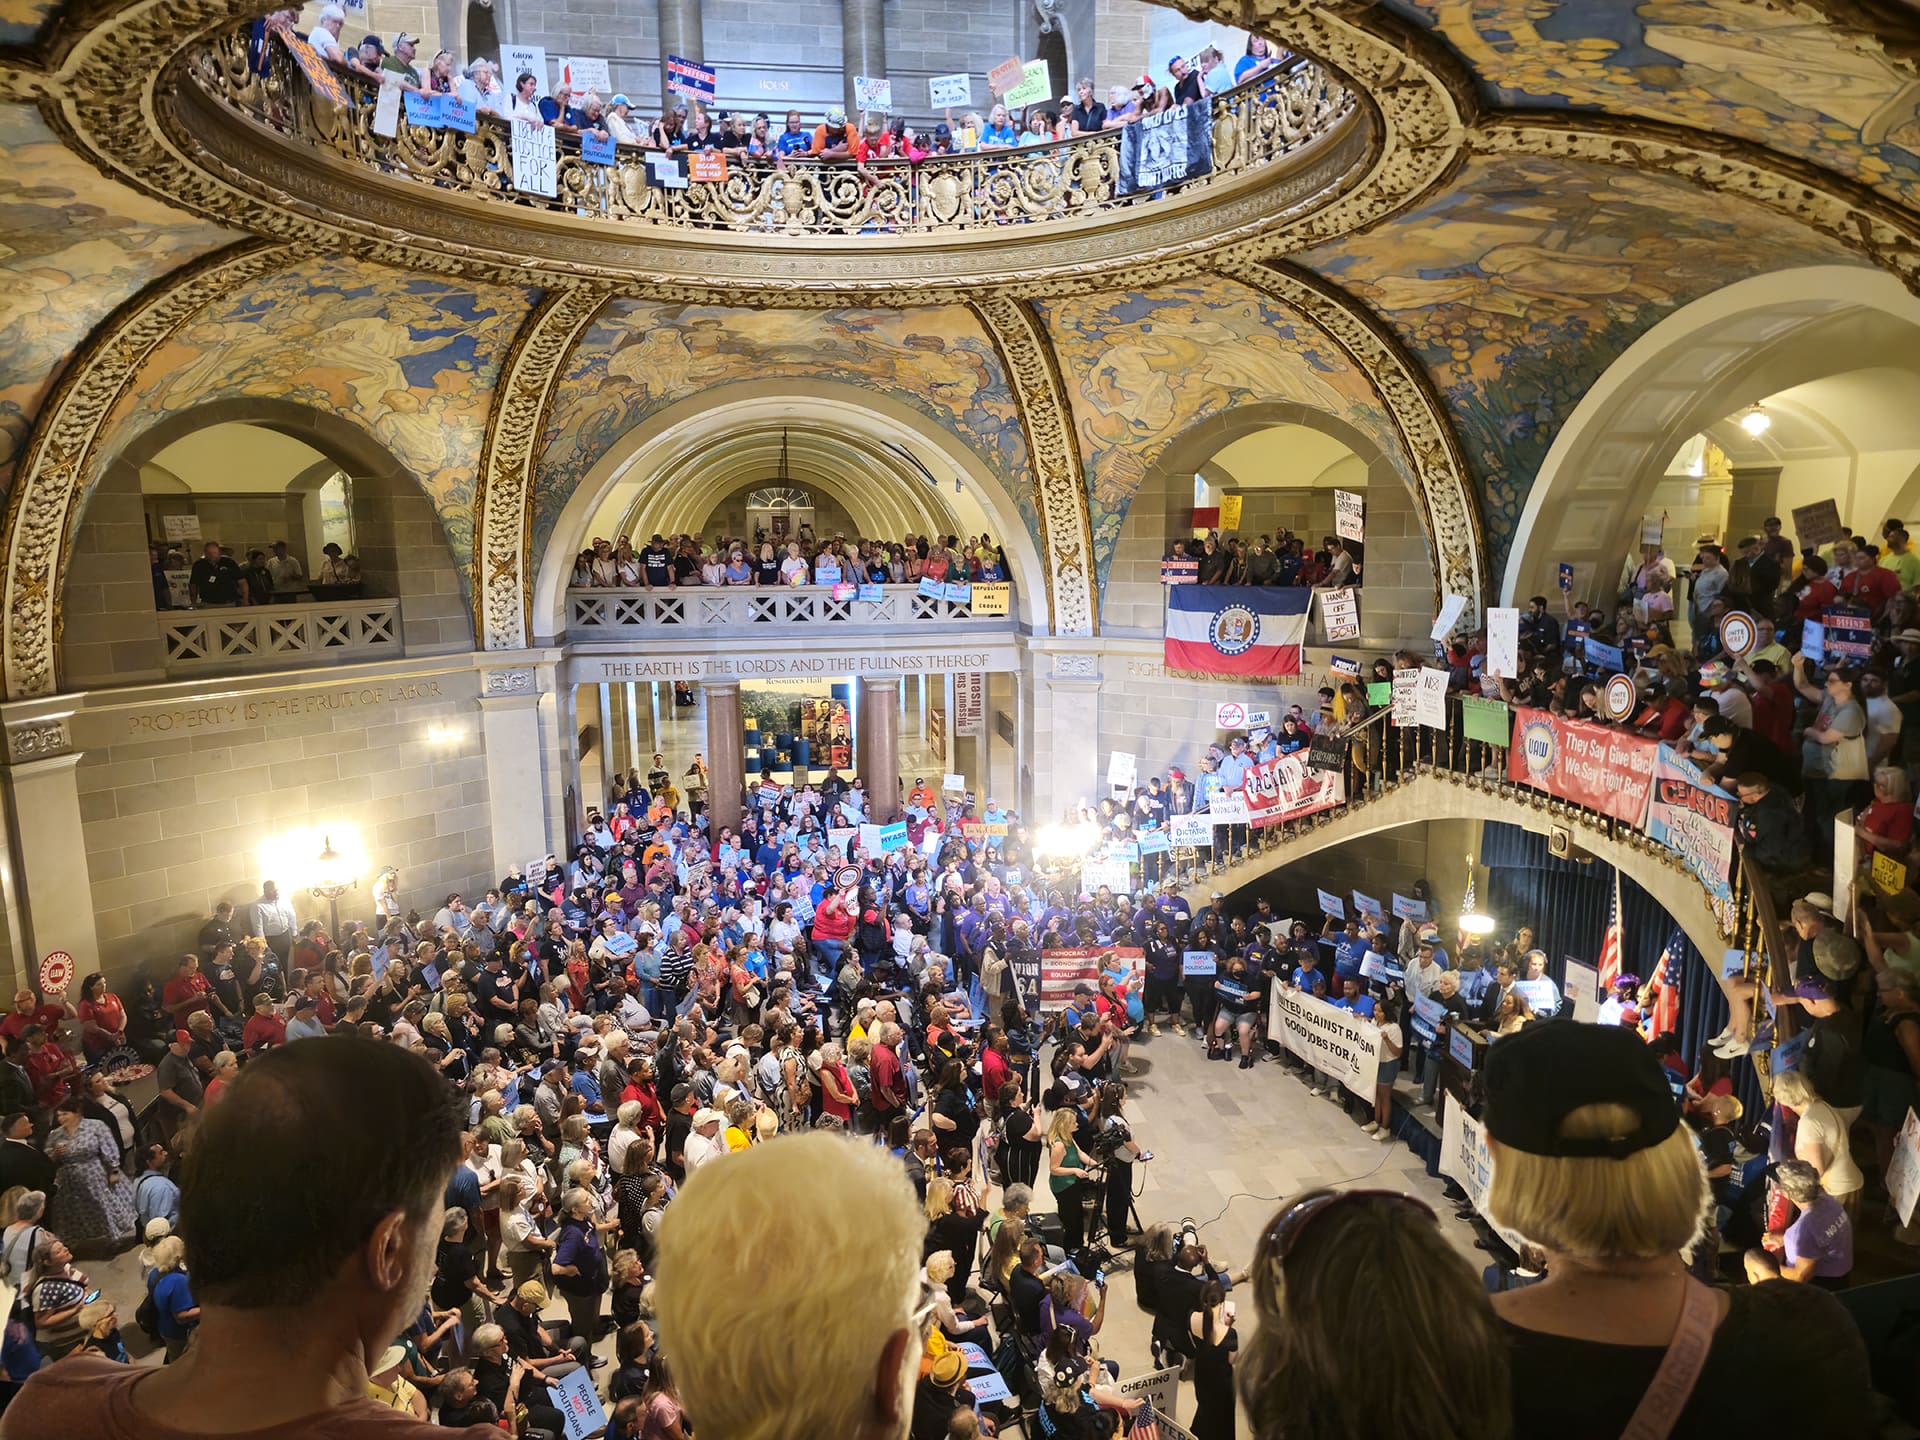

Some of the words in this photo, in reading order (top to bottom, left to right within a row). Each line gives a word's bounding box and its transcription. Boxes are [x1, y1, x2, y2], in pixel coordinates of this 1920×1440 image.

[682, 67, 711, 82] DEFEND
[759, 80, 789, 91] HOUSE
[448, 100, 469, 112] PEOPLE
[451, 109, 464, 117] NOT
[442, 112, 474, 127] POLITICIANS
[513, 138, 555, 161] JUSTICE
[519, 156, 548, 177] FOR
[519, 175, 549, 193] ALL
[1326, 590, 1350, 603] HANDS
[1333, 604, 1345, 613] OFF
[1335, 616, 1346, 625] MY
[1836, 617, 1865, 628] DEFEND
[1727, 628, 1745, 637] UNITE
[1824, 640, 1871, 656] CONSTITUTION
[601, 662, 631, 676] THE
[636, 661, 683, 676] EARTH
[688, 661, 700, 675] IS
[702, 660, 732, 674] THE
[736, 659, 786, 673] LORD'S
[790, 658, 824, 672] AND
[828, 657, 855, 671] THE
[860, 656, 923, 670] FULLNESS
[927, 654, 990, 668] THEREOF
[1335, 659, 1357, 672] PEOPLE
[765, 676, 805, 685] Resources
[807, 675, 822, 684] Hall
[1611, 691, 1626, 699] UNITE
[129, 703, 238, 735] PROPERTY
[244, 702, 258, 720] IS
[262, 696, 299, 717] THE
[305, 691, 354, 714] FRUIT
[359, 688, 383, 706] OF
[389, 680, 442, 701] LABOR
[957, 691, 967, 727] Missouri
[1250, 713, 1265, 723] UAW
[1528, 737, 1548, 757] UAW
[1565, 732, 1588, 756] They
[1589, 738, 1606, 760] Say
[1609, 744, 1629, 766] Give
[1565, 756, 1581, 775] We
[1581, 763, 1598, 785] Say
[1600, 770, 1623, 793] Fight
[1660, 779, 1729, 825] CENSOR
[881, 836, 892, 845] MY
[892, 831, 907, 840] ASS
[1176, 827, 1207, 836] DICTATOR
[1175, 837, 1210, 845] MISSOURI
[1881, 858, 1898, 872] STOP
[51, 969, 65, 978] UAW
[1302, 1009, 1344, 1036] AGAINST
[1285, 1017, 1307, 1038] GOOD
[1307, 1031, 1328, 1050] JOBS
[1329, 1042, 1349, 1060] FOR
[1825, 1223, 1837, 1238] NO
[1121, 1373, 1170, 1393] CHEATING
[572, 1394, 585, 1414] NOT
[577, 1383, 596, 1416] PEOPLE
[559, 1383, 584, 1437] POLITICIANS
